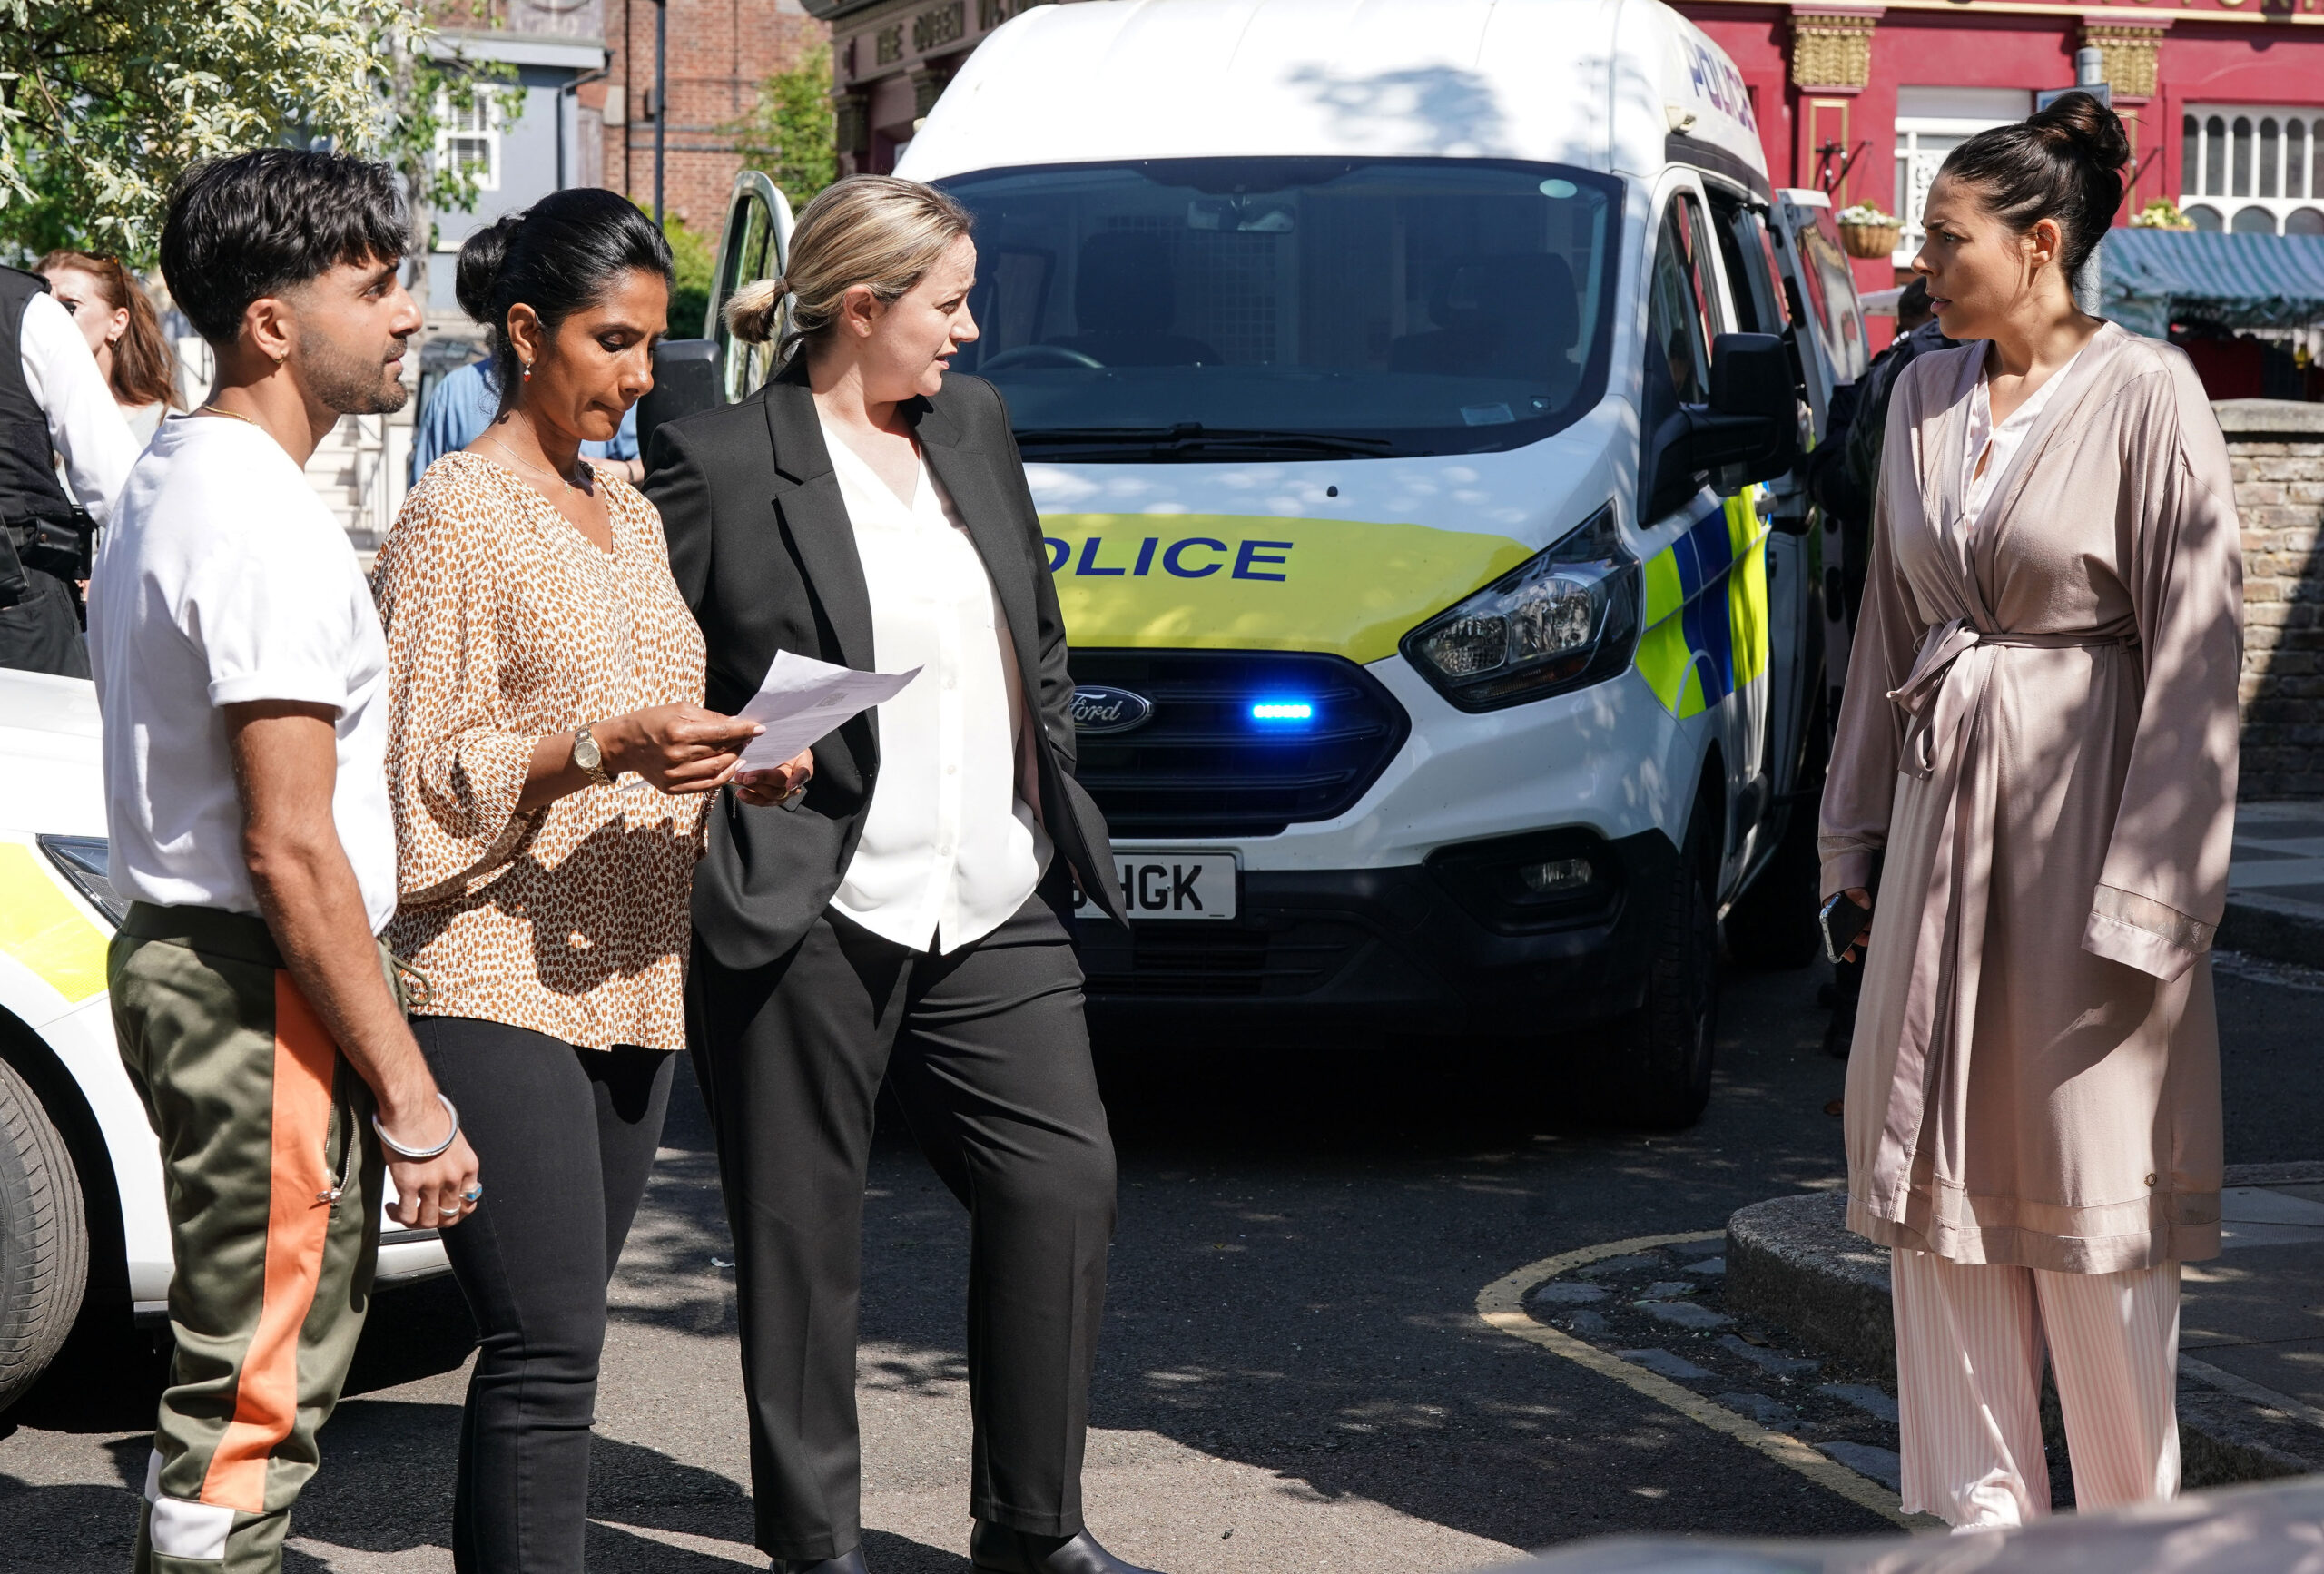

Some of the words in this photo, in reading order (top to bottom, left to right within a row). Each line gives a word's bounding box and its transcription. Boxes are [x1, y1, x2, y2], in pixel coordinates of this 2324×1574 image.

[877, 23, 904, 66] THE
[913, 1, 965, 53] QUEEN
[1679, 34, 1755, 133] POLICE
[1043, 536, 1294, 582] LICE
[1072, 693, 1123, 721] Ford
